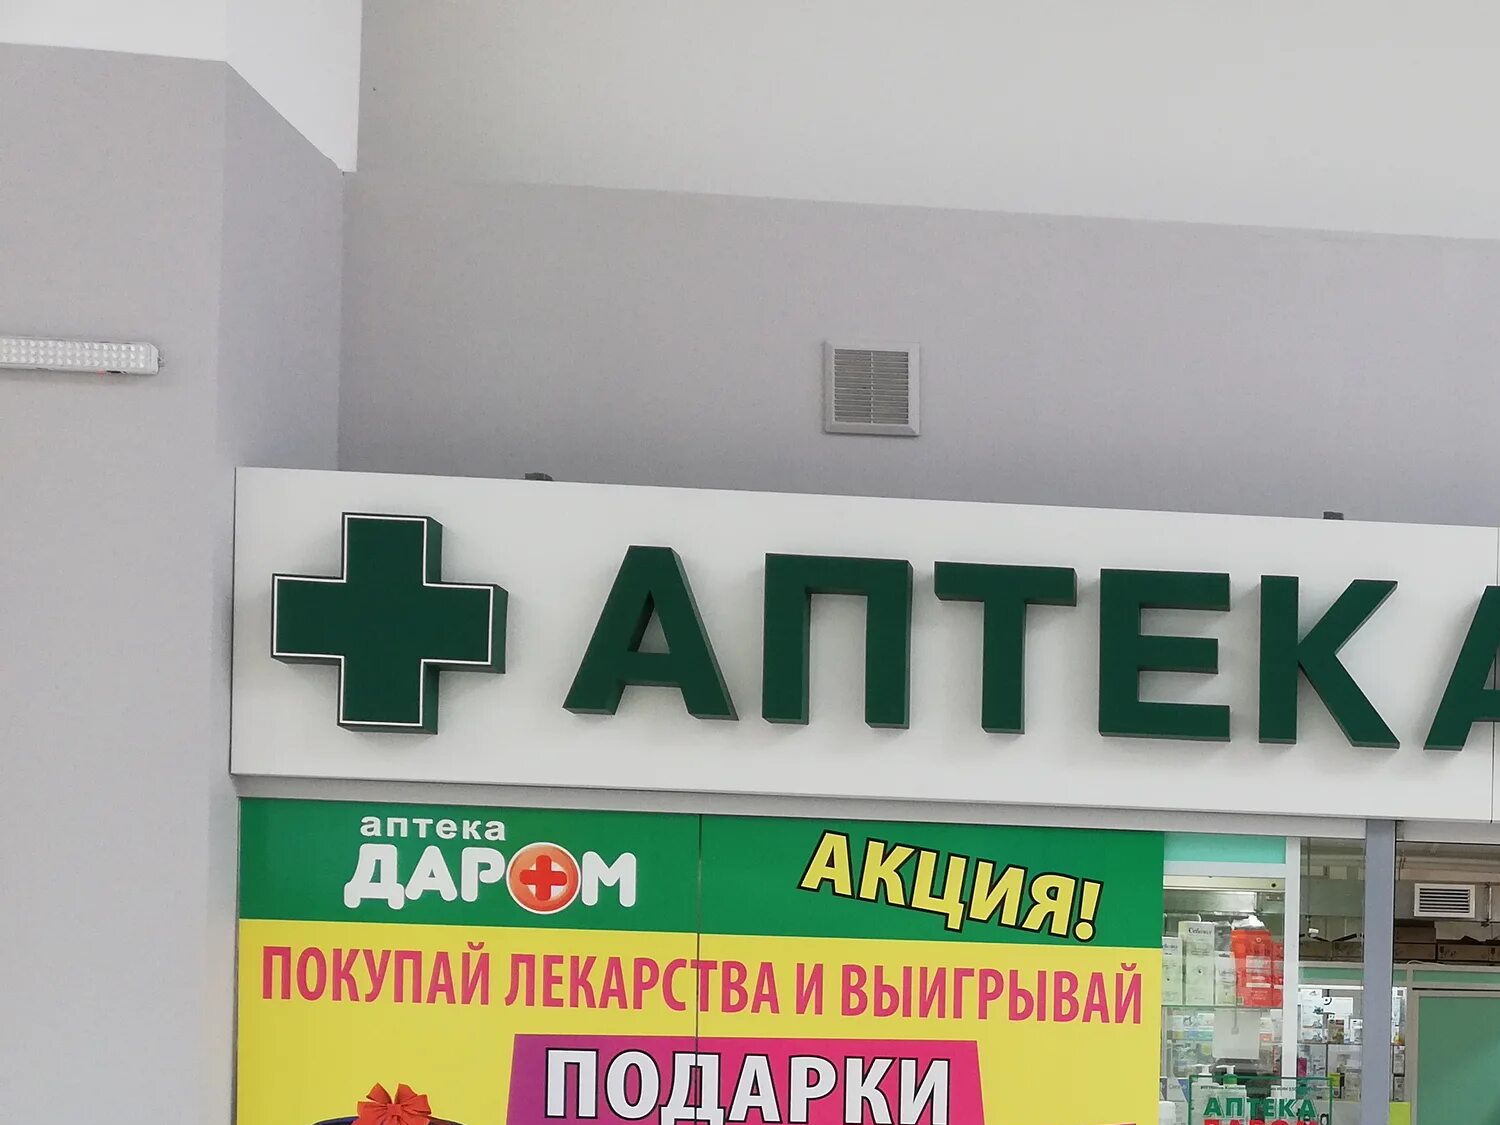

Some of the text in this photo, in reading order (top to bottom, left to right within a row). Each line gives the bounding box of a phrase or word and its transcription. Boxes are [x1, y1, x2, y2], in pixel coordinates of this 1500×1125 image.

[360, 816, 506, 841] аптека
[343, 842, 637, 915] ДАРОМ
[797, 829, 1103, 943] АКЦИЯ!
[262, 941, 1143, 1025] ПОКУПАЙ ЛЕКАРСТВА И ВЫИГРЫВАЙ
[1203, 1097, 1316, 1118] АПТЕКА
